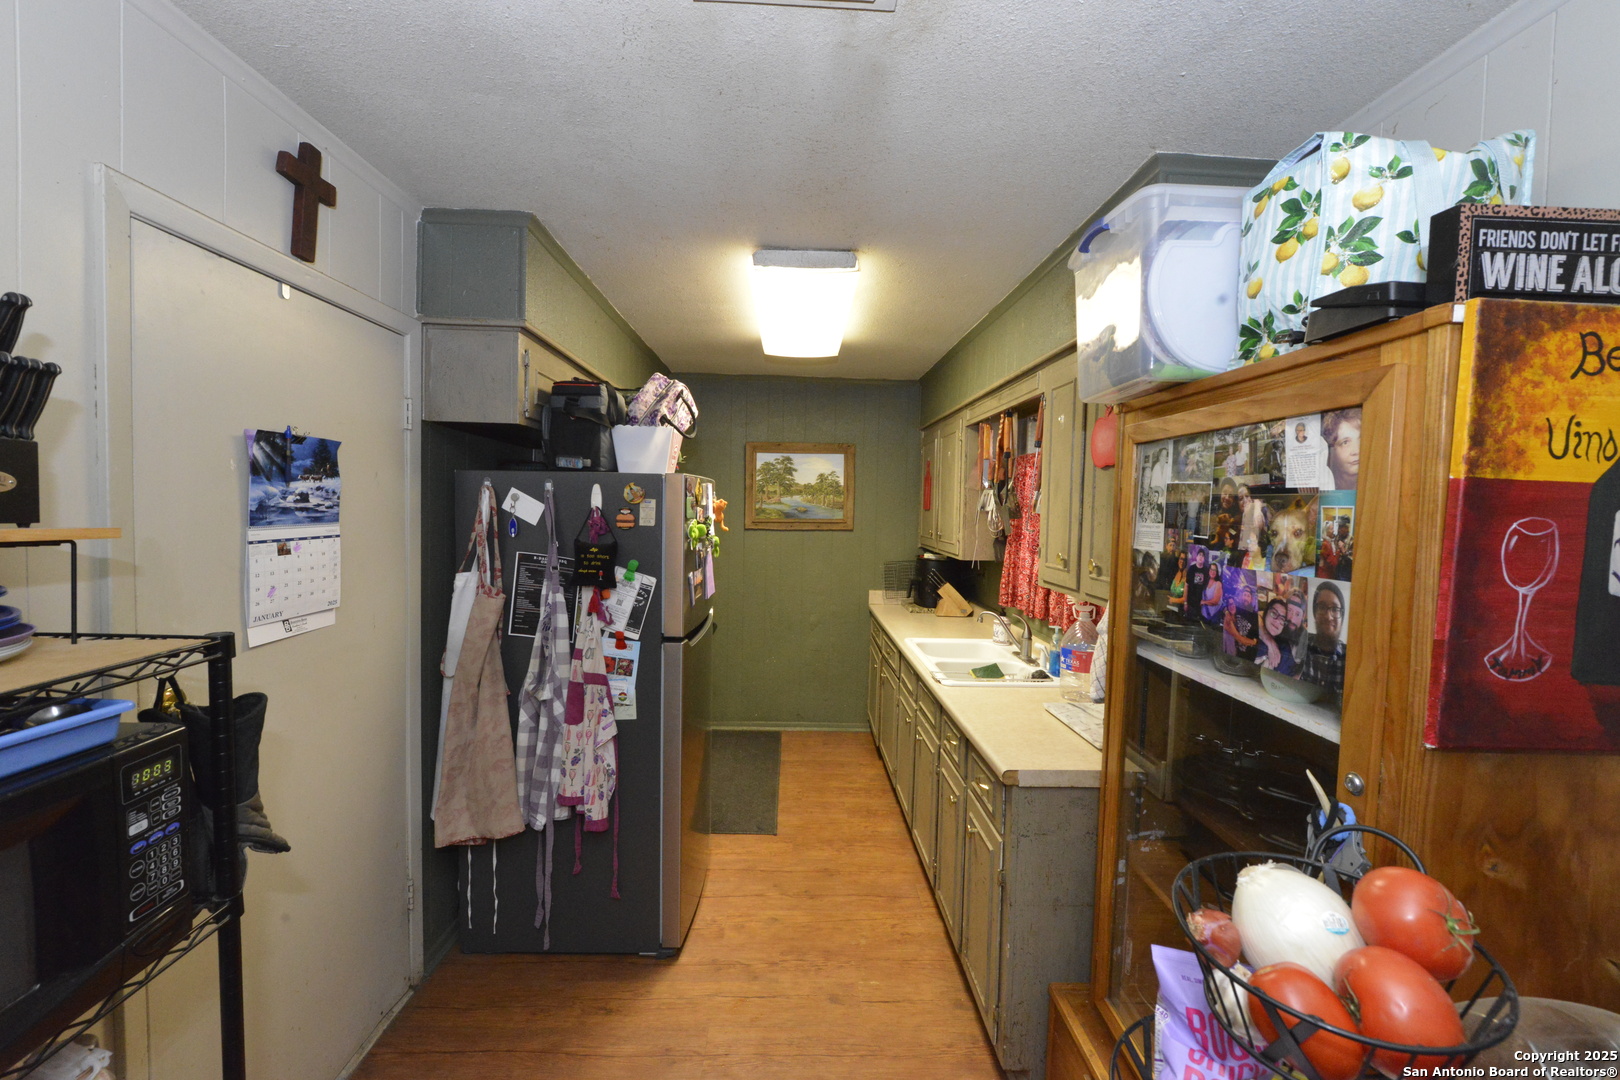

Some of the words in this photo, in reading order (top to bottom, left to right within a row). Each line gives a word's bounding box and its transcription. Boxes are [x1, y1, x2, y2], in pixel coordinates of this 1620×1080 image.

[1478, 228, 1537, 249] FRIENDS
[1540, 230, 1580, 251] DON'T
[1582, 232, 1608, 252] LET
[1481, 251, 1567, 292] WINE
[253, 610, 284, 623] JANUARY
[327, 599, 338, 607] 2025
[161, 843, 167, 852] 2
[172, 837, 178, 845] 3
[149, 862, 155, 870] 4
[161, 854, 167, 863] 5
[172, 848, 178, 856] 6
[150, 873, 156, 881] 7
[161, 865, 167, 874] 8
[173, 858, 179, 867] 9
[162, 876, 168, 885] 0
